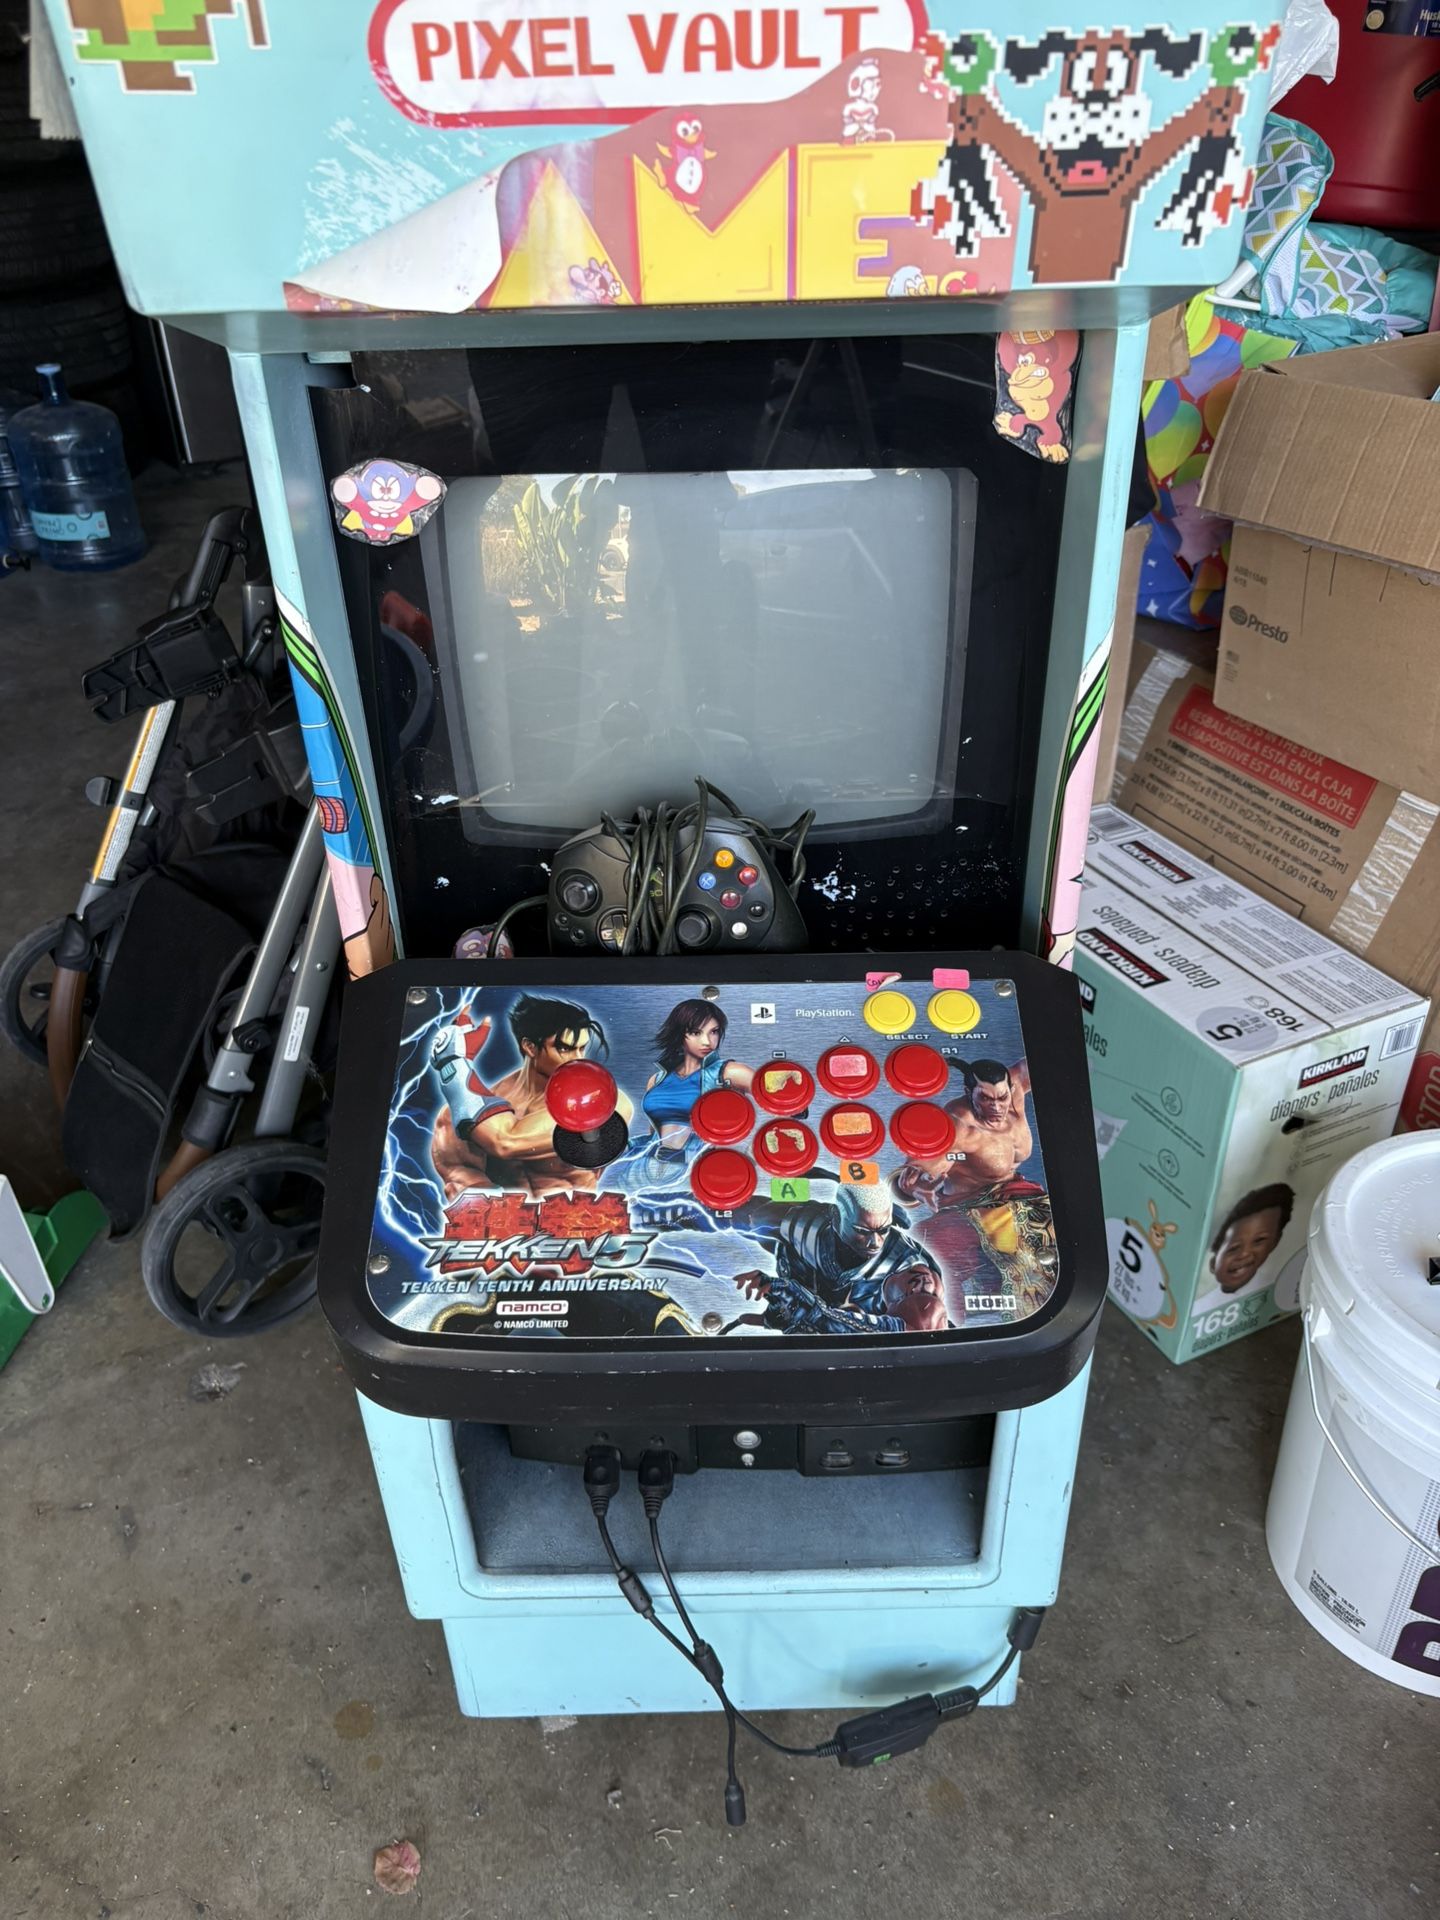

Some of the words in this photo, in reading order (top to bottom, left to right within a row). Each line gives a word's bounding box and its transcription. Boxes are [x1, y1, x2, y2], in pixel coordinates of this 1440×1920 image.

[411, 17, 615, 82] PIXEL
[628, 6, 880, 75] VAULT
[1247, 614, 1288, 643] Presto
[1174, 720, 1188, 733] LA
[1186, 726, 1250, 765] DIAPOSITIVE
[1248, 757, 1269, 775] EST
[1267, 768, 1302, 792] DANS
[1299, 784, 1318, 801] LA
[1187, 708, 1261, 752] RESBALADILLA
[1259, 742, 1289, 766] ESTÁ
[1286, 758, 1305, 775] EN
[1302, 767, 1321, 784] LA
[1319, 775, 1354, 800] CAJA
[1300, 748, 1324, 766] BOX
[1121, 841, 1183, 884] KIRKLAND
[1282, 829, 1290, 840] ft
[1309, 845, 1318, 857] in
[1318, 850, 1349, 875] [2.3m]
[1298, 870, 1308, 884] in
[1307, 874, 1338, 901] [4.3m]
[1093, 905, 1160, 946] pañales
[1072, 928, 1157, 989] KIRKLAND
[1155, 948, 1222, 989] diapers
[1206, 1024, 1243, 1041] 5
[1264, 1007, 1304, 1032] 168
[1084, 1024, 1108, 1057] ales
[1303, 1049, 1367, 1080] KIRKLAND
[1270, 1091, 1320, 1122] diapers
[1327, 1069, 1380, 1103] pañales
[847, 1162, 866, 1181] B
[946, 1153, 966, 1161] R2
[780, 1182, 797, 1199] A
[418, 1232, 607, 1268] TEKKEN
[593, 1232, 659, 1268] 5
[1119, 1230, 1143, 1273] 5
[401, 1281, 470, 1294] TEKKEN
[477, 1280, 534, 1293] TENTH
[540, 1278, 668, 1292] ANNIVERSARY
[501, 1303, 562, 1312] namco
[966, 1296, 1016, 1310] HORI
[503, 1320, 534, 1328] NAMCO
[535, 1319, 569, 1328] LIMITED
[1192, 1303, 1240, 1339] 168
